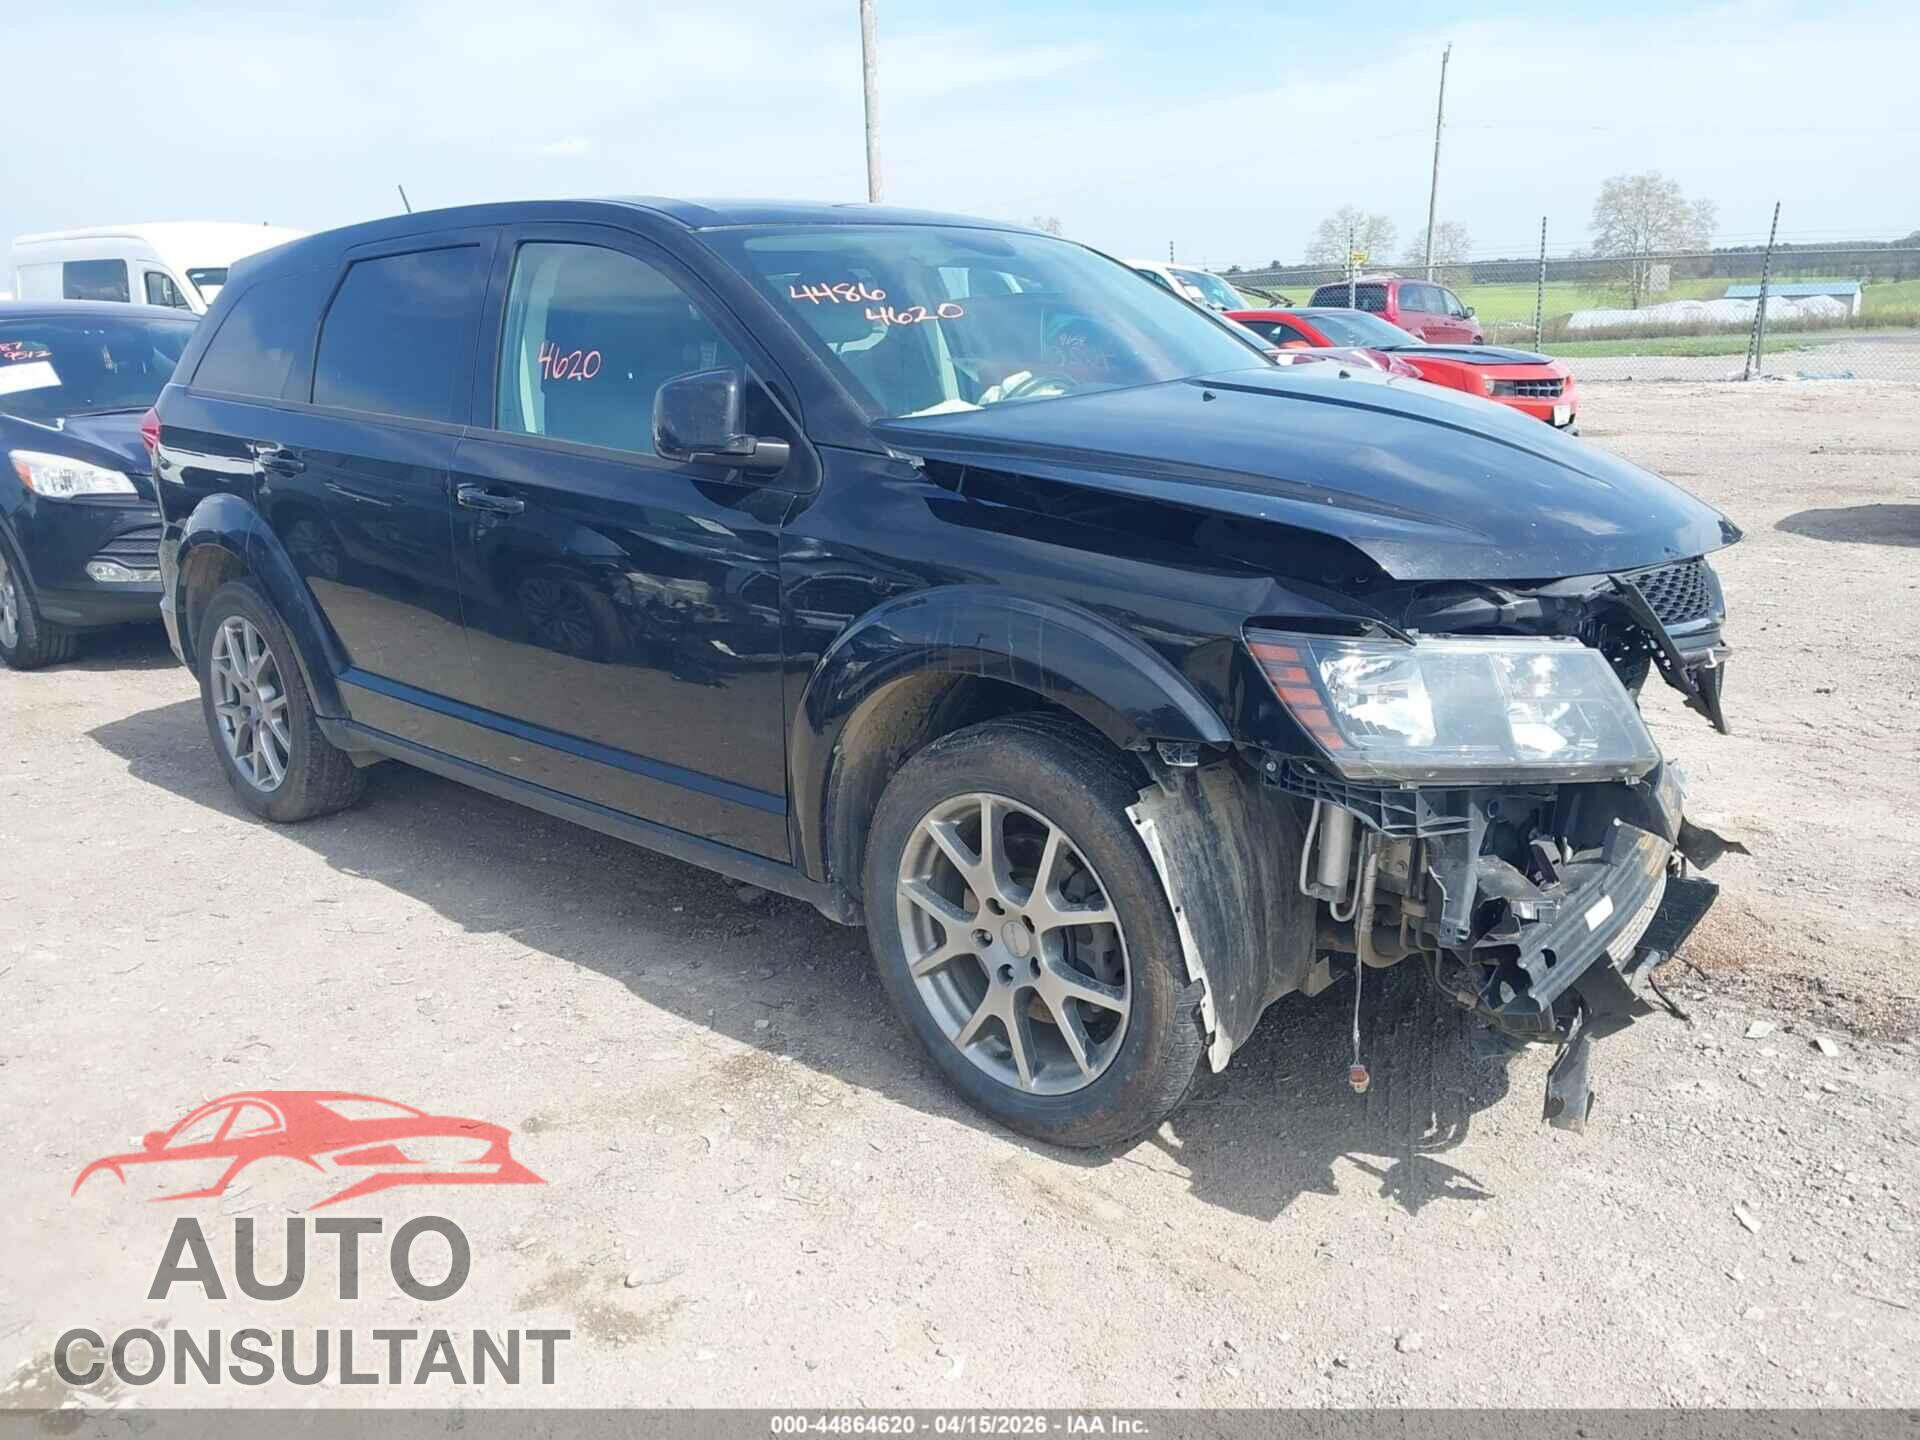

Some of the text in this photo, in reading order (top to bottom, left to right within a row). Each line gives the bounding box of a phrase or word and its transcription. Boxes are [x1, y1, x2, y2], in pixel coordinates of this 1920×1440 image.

[789, 282, 887, 305] 4486
[864, 302, 964, 326] 4620
[538, 341, 601, 381] 4620
